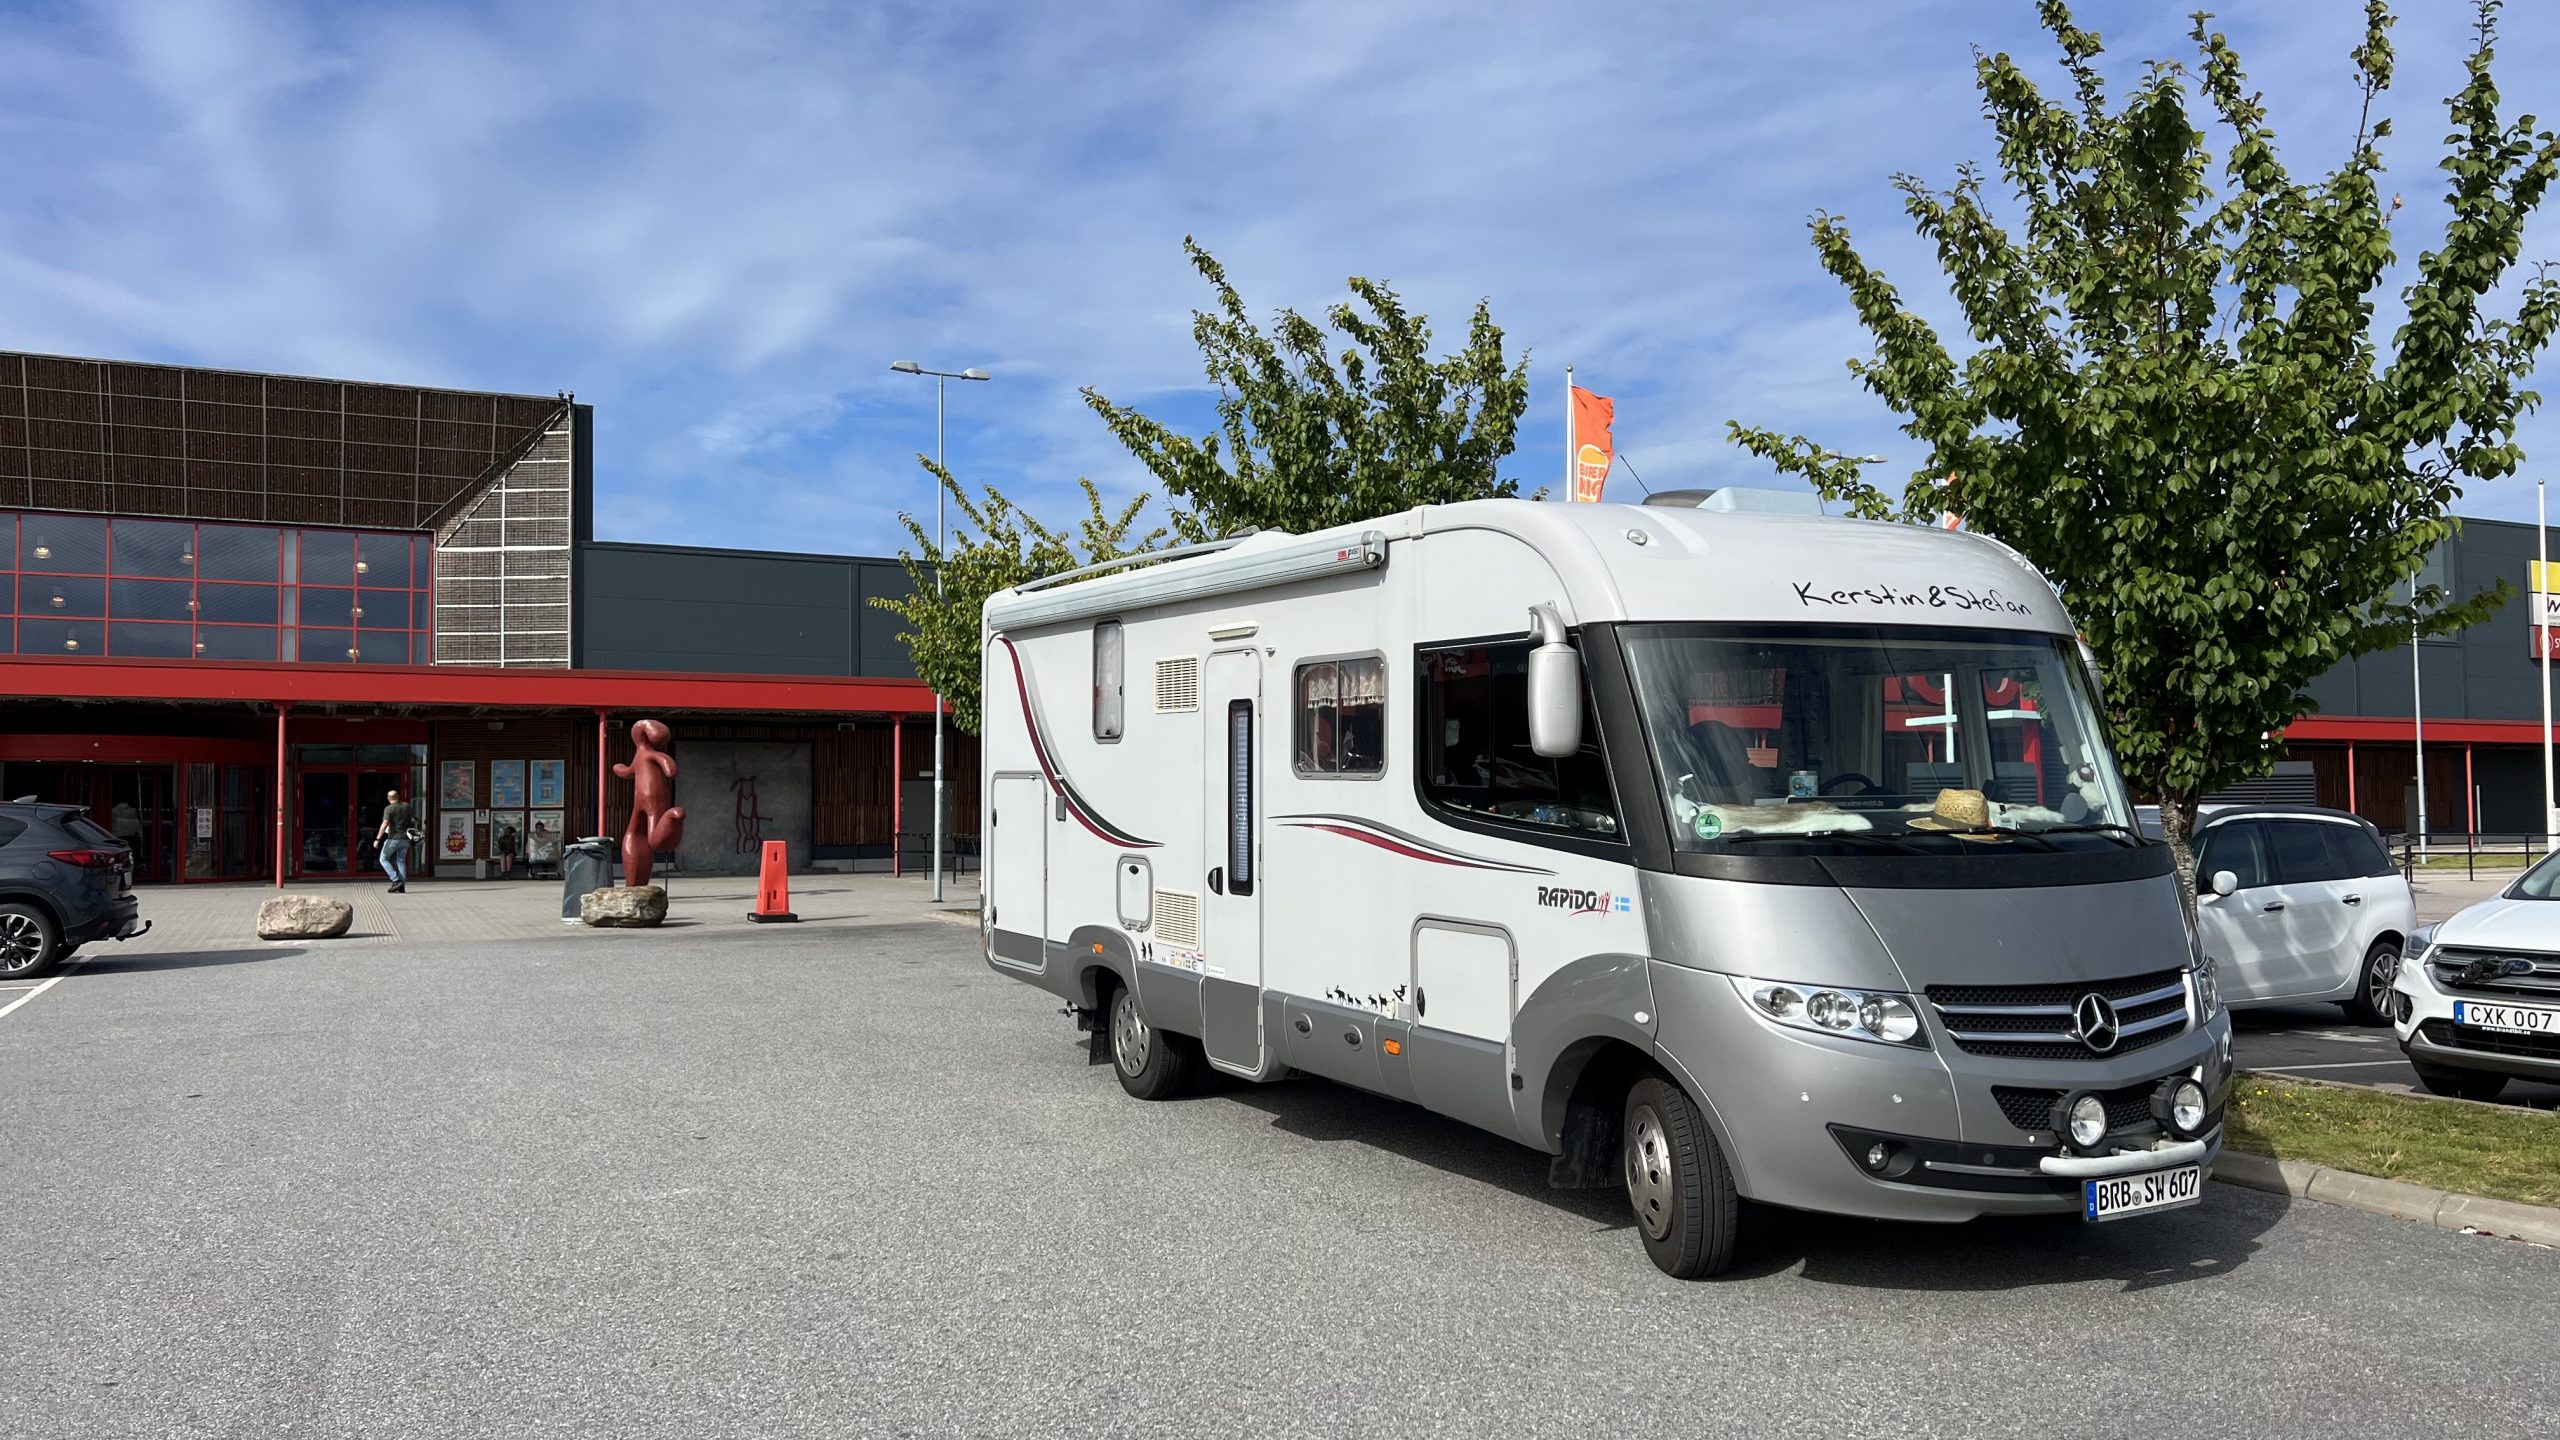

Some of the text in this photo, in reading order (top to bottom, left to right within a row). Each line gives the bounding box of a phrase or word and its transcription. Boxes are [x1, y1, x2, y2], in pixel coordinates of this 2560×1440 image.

[1704, 815, 1713, 826] 4
[2471, 1006, 2553, 1030] CXK 007
[2098, 1180, 2132, 1211] BRB
[2144, 1174, 2165, 1203] SW
[2169, 1168, 2198, 1199] 607
[2089, 1202, 2095, 1211] D
